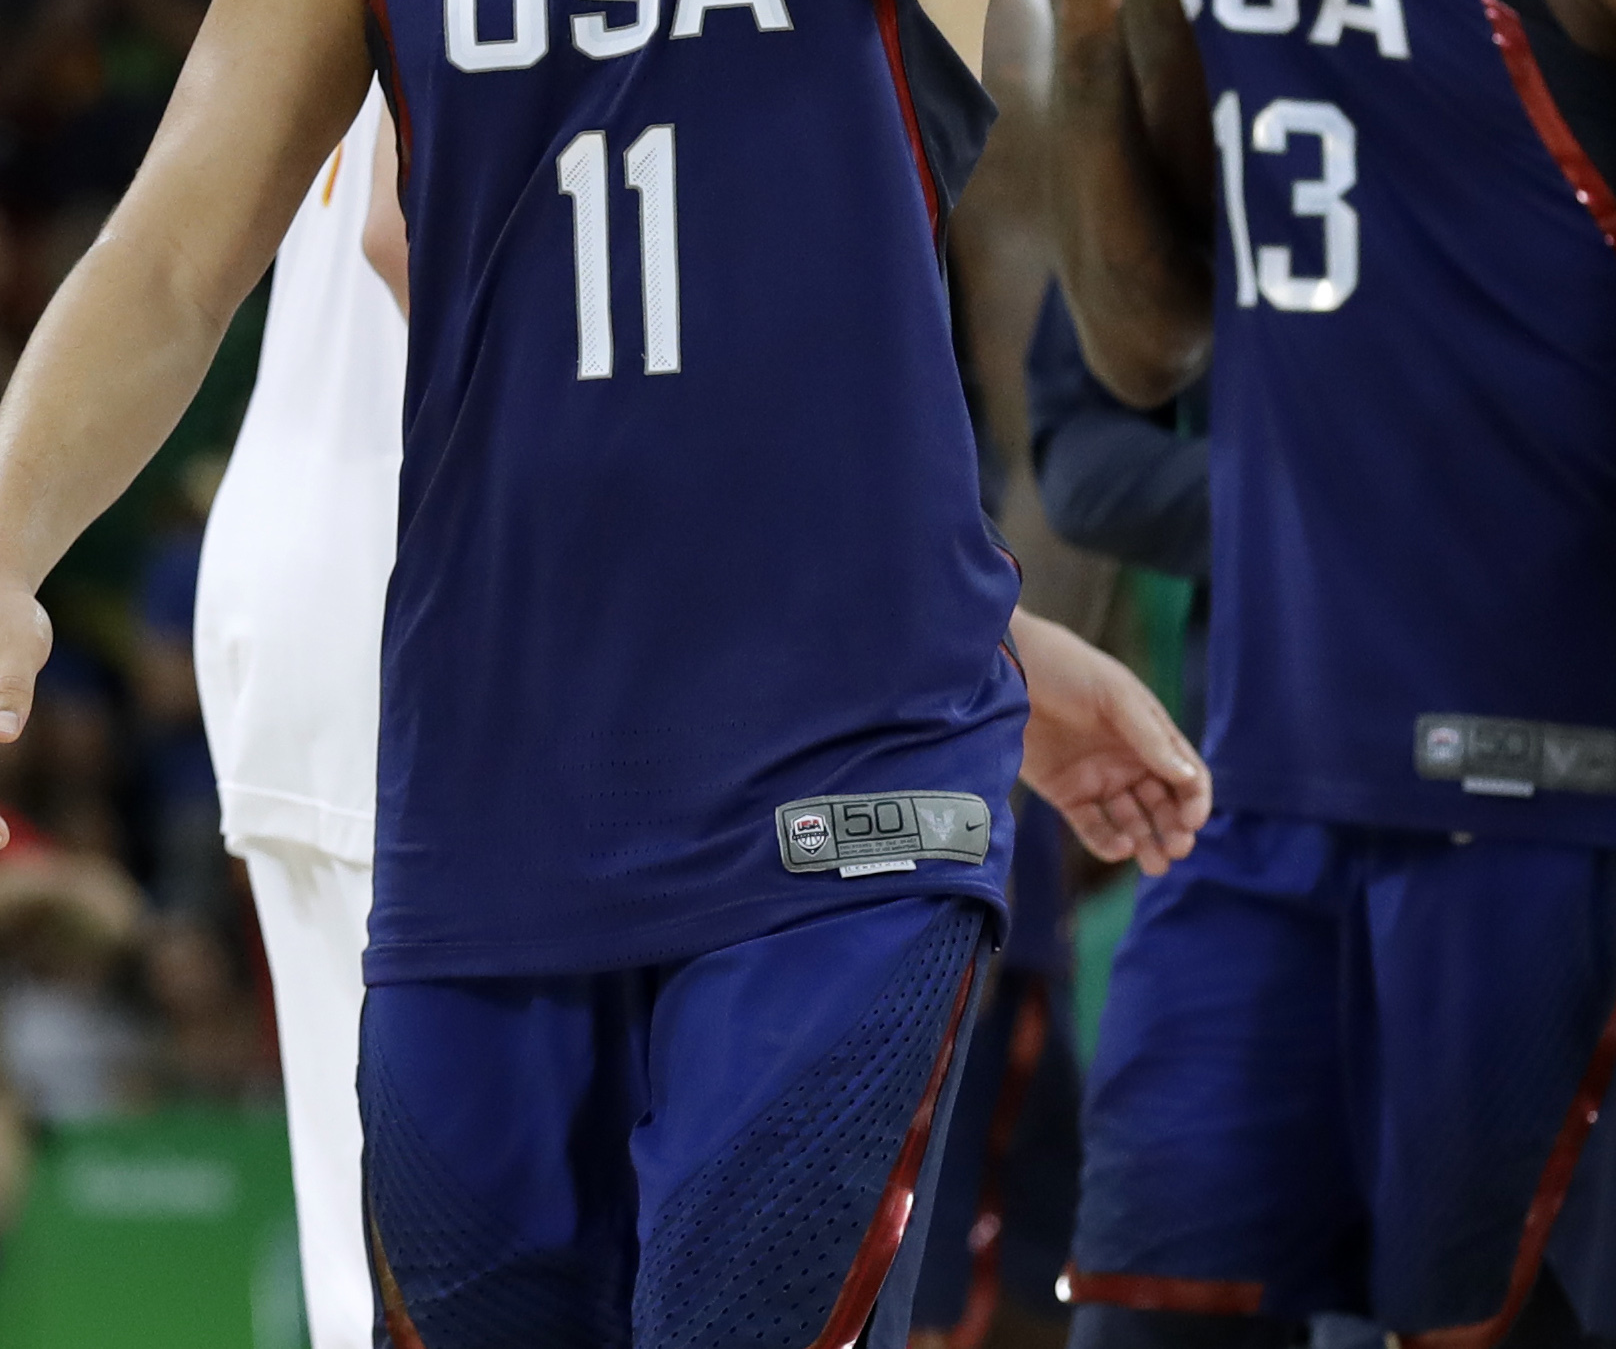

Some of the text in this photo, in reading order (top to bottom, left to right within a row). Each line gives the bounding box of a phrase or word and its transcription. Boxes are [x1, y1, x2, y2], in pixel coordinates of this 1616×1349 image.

[556, 123, 681, 381] 11
[1212, 90, 1360, 312] 13
[843, 801, 903, 837] 50
